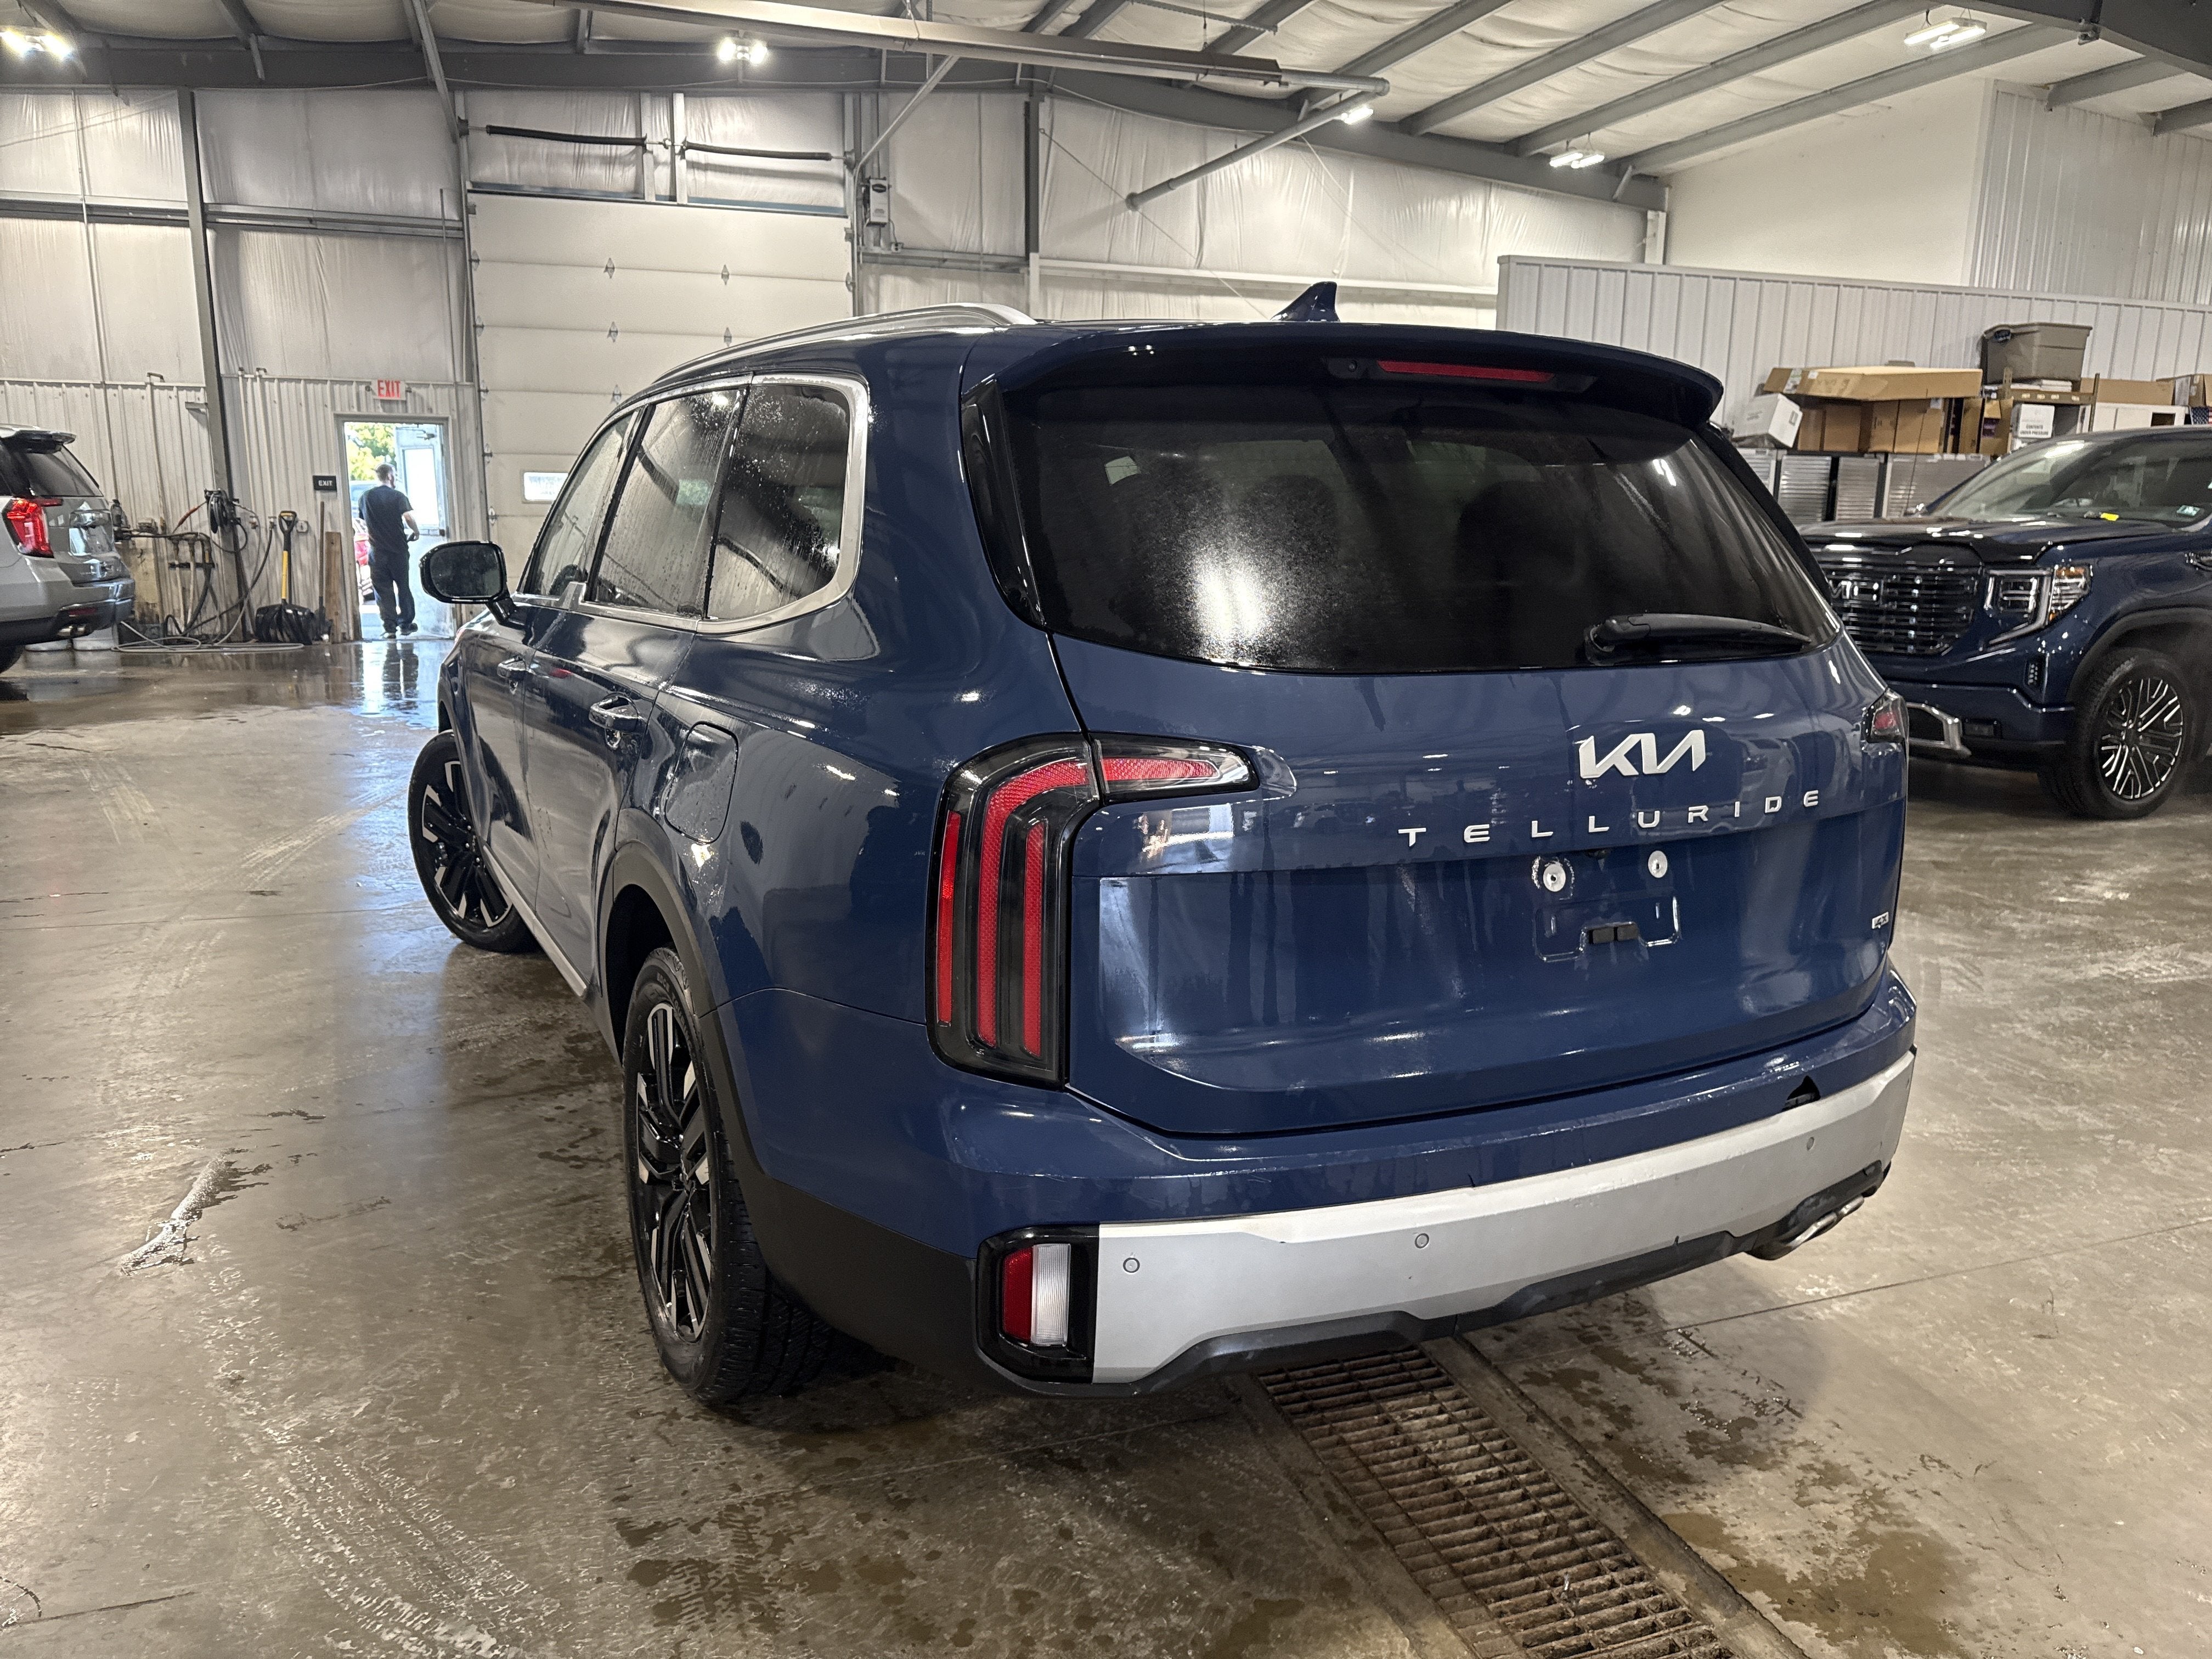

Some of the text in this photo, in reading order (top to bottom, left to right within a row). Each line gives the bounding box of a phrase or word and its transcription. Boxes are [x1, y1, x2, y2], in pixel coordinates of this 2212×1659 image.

[377, 380, 400, 397] EXIT
[1829, 579, 1880, 601] MC
[1579, 730, 1706, 779] KIA
[1397, 789, 1819, 848] TELLURIDE
